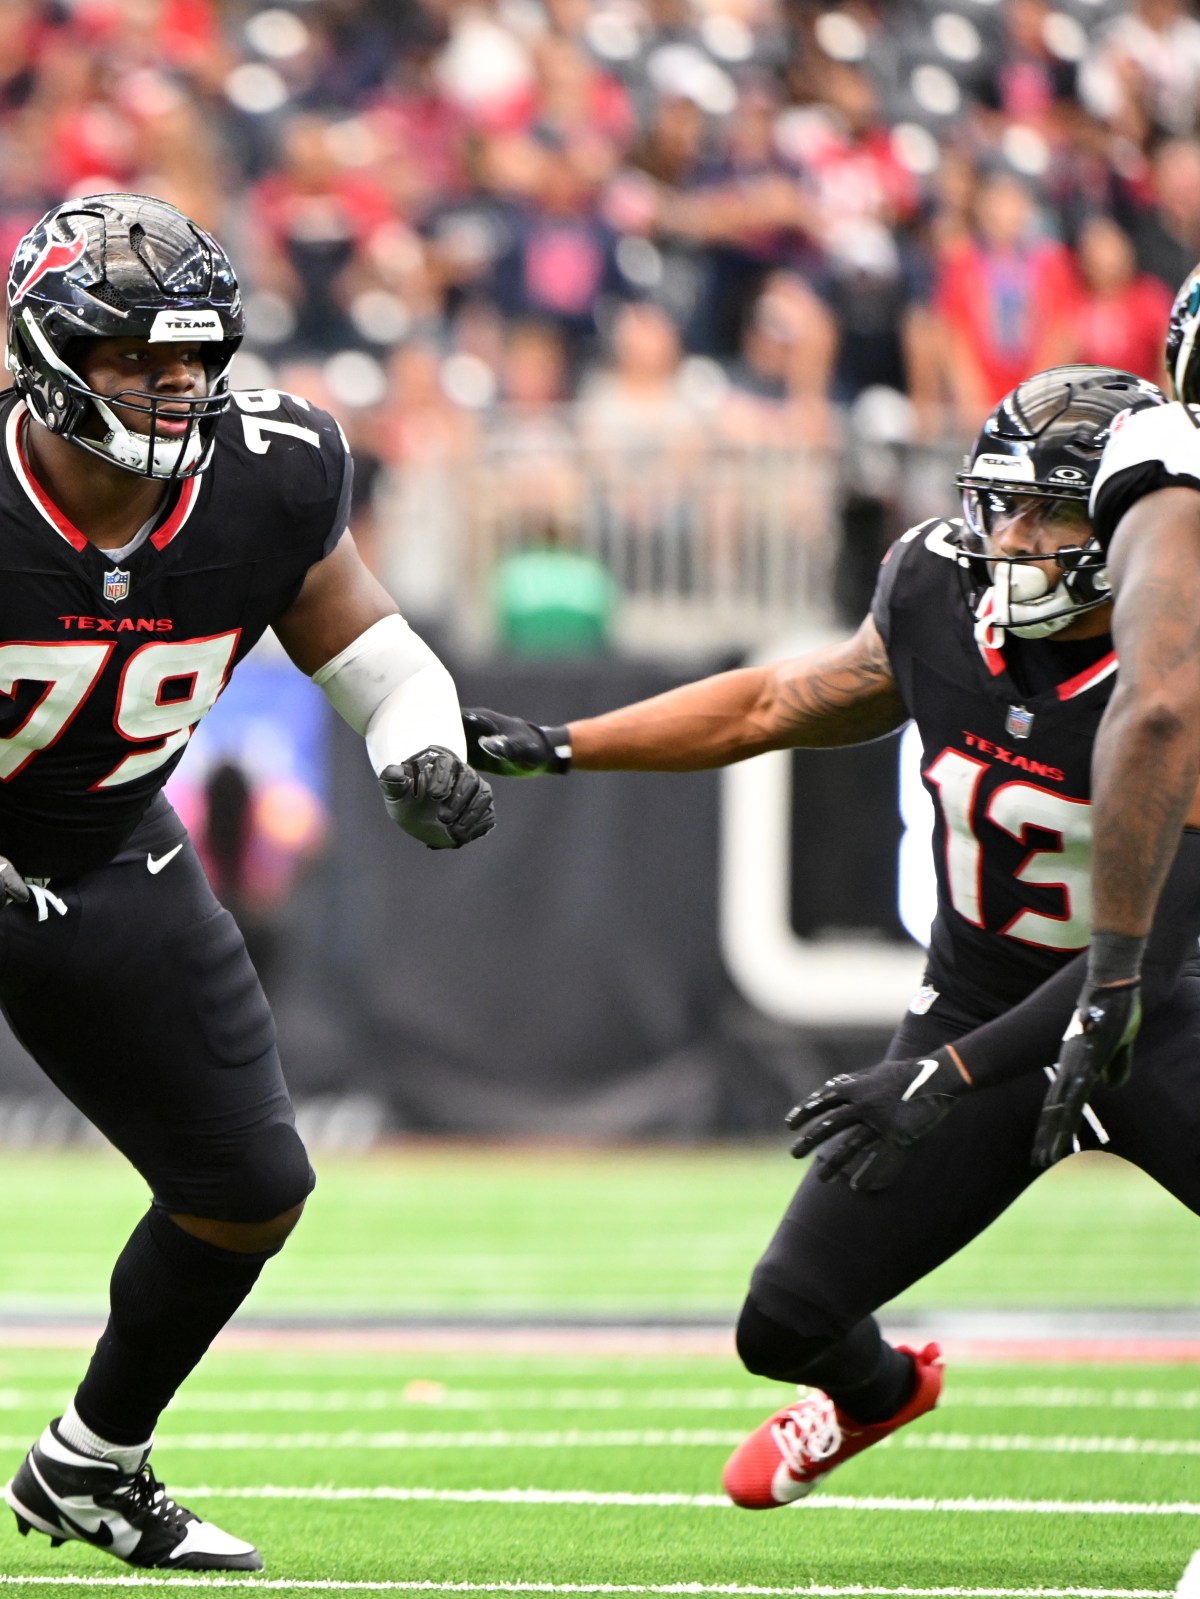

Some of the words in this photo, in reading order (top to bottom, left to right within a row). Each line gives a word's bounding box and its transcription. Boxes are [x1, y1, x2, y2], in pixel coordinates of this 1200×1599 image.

[107, 584, 126, 596] NFL
[58, 616, 173, 632] TEXANS
[962, 730, 1065, 781] TEXANS
[923, 746, 1093, 952] 13
